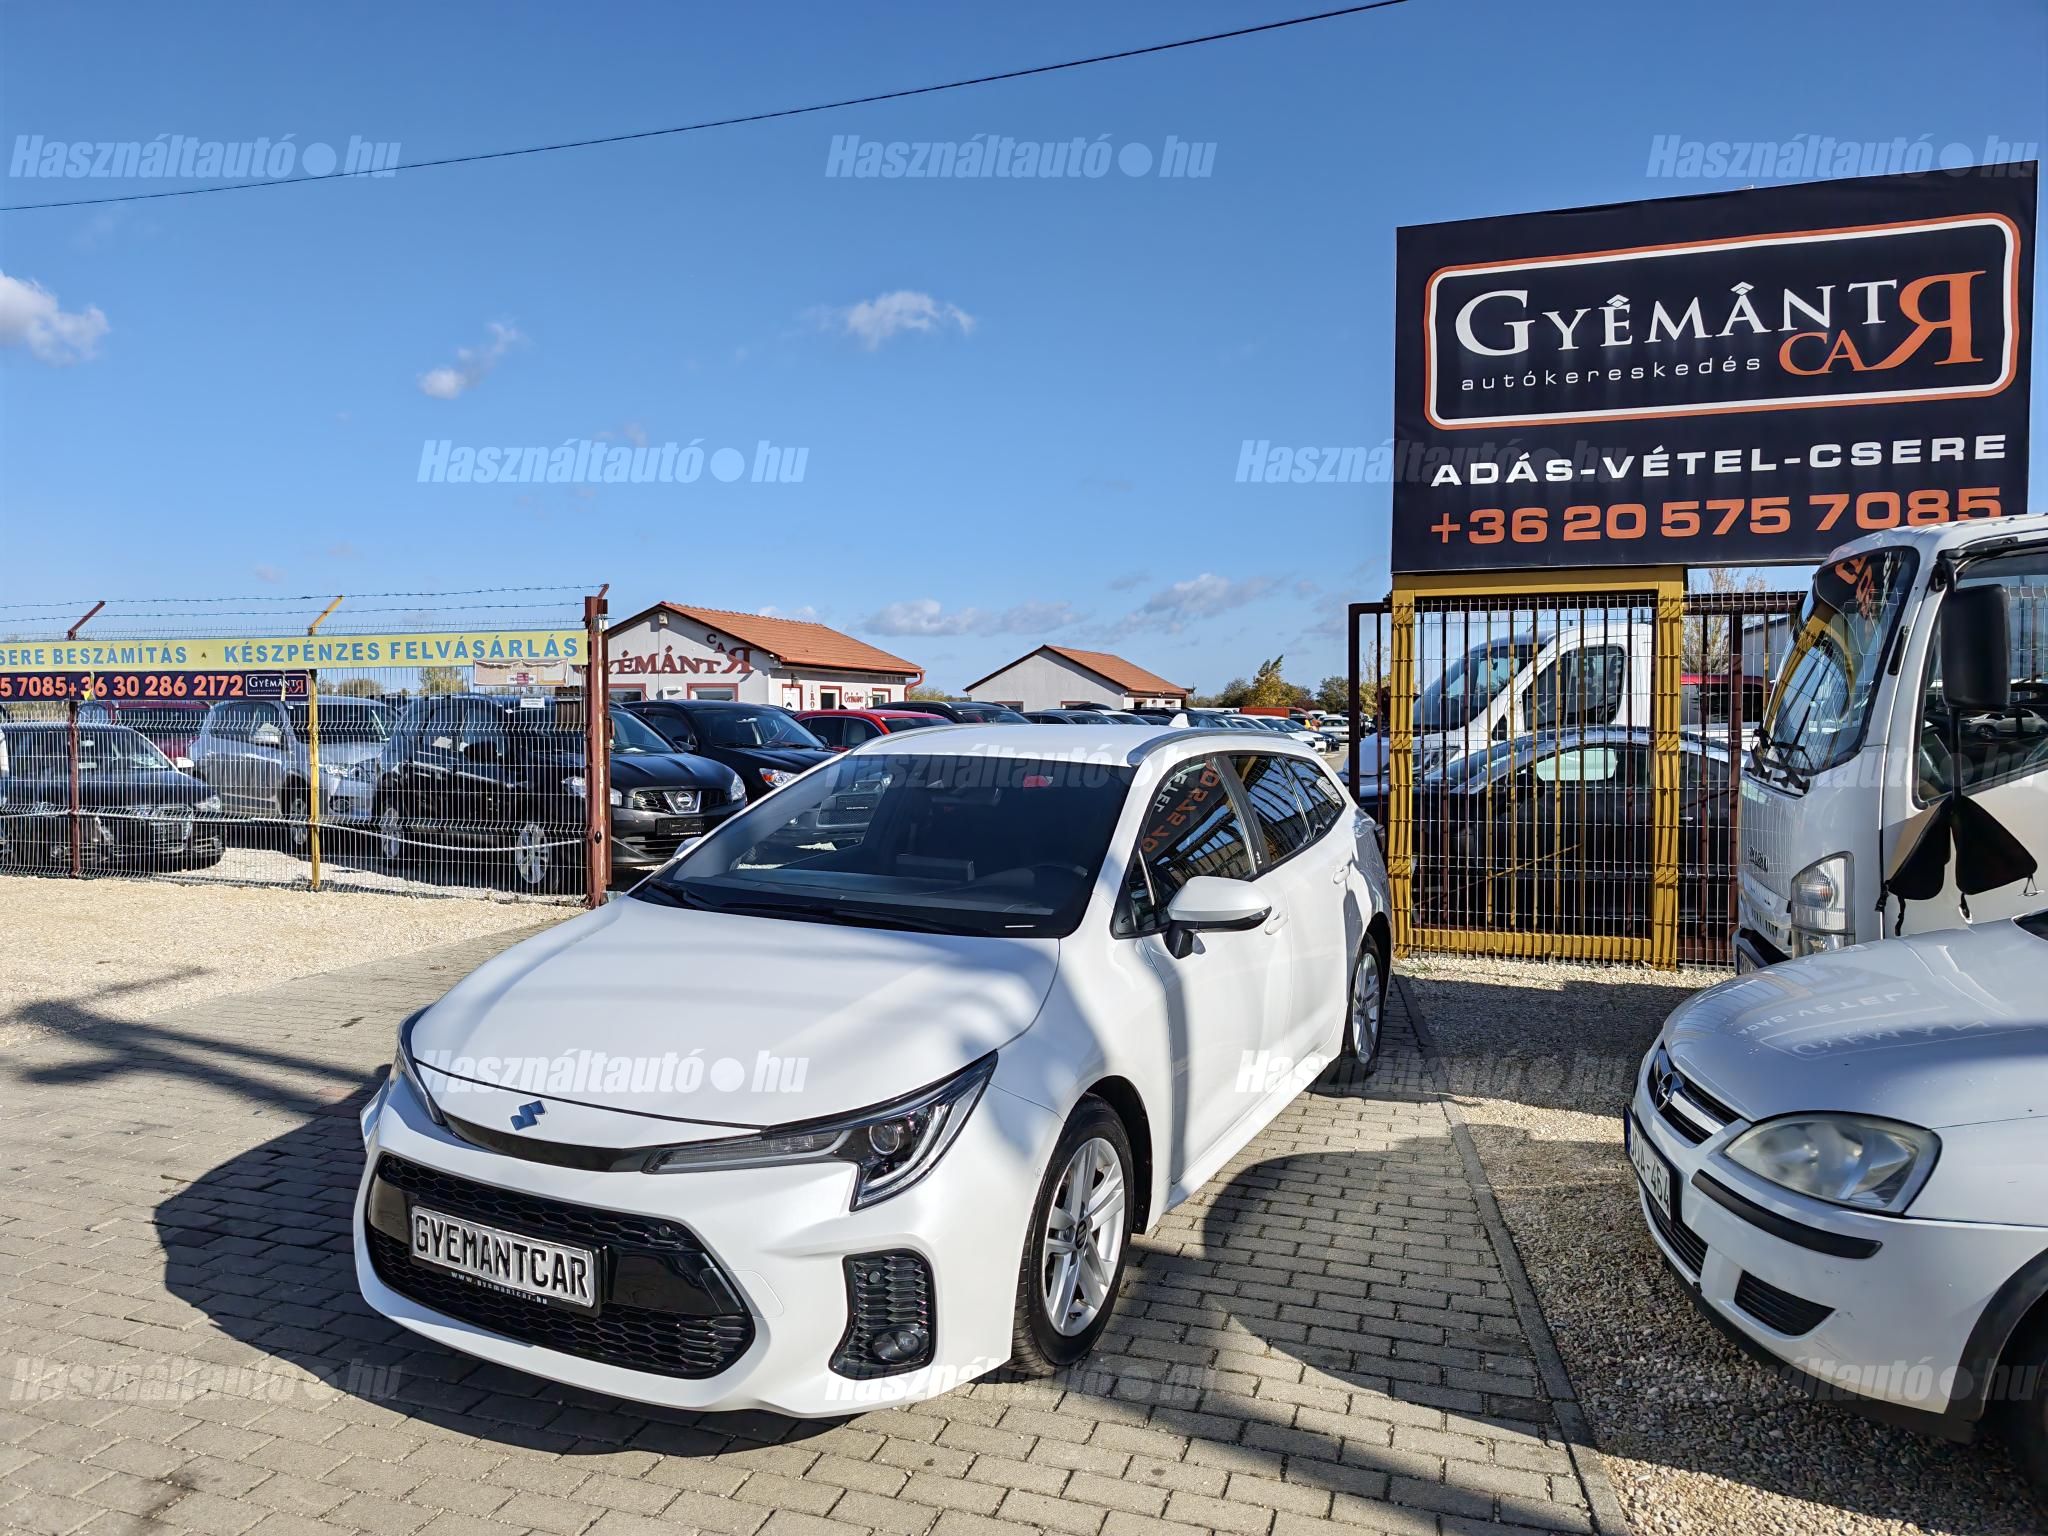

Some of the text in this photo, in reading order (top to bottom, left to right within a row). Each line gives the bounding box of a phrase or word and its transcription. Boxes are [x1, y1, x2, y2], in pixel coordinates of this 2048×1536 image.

[1461, 355, 1760, 391] autókereskedés
[1430, 486, 2003, 544] +36 20 575 7085
[53, 642, 187, 665] BESZÁMÍTÁS
[224, 639, 381, 664] KÉSZPÉNZES
[390, 633, 578, 661] FELVÁSÁRLÁS
[608, 644, 722, 675] YÉMÁNT
[17, 676, 67, 697] 7085
[113, 675, 139, 697] 30
[145, 674, 187, 697] 286
[193, 673, 244, 696] 2172
[415, 1214, 588, 1299] GYEMANTCAR
